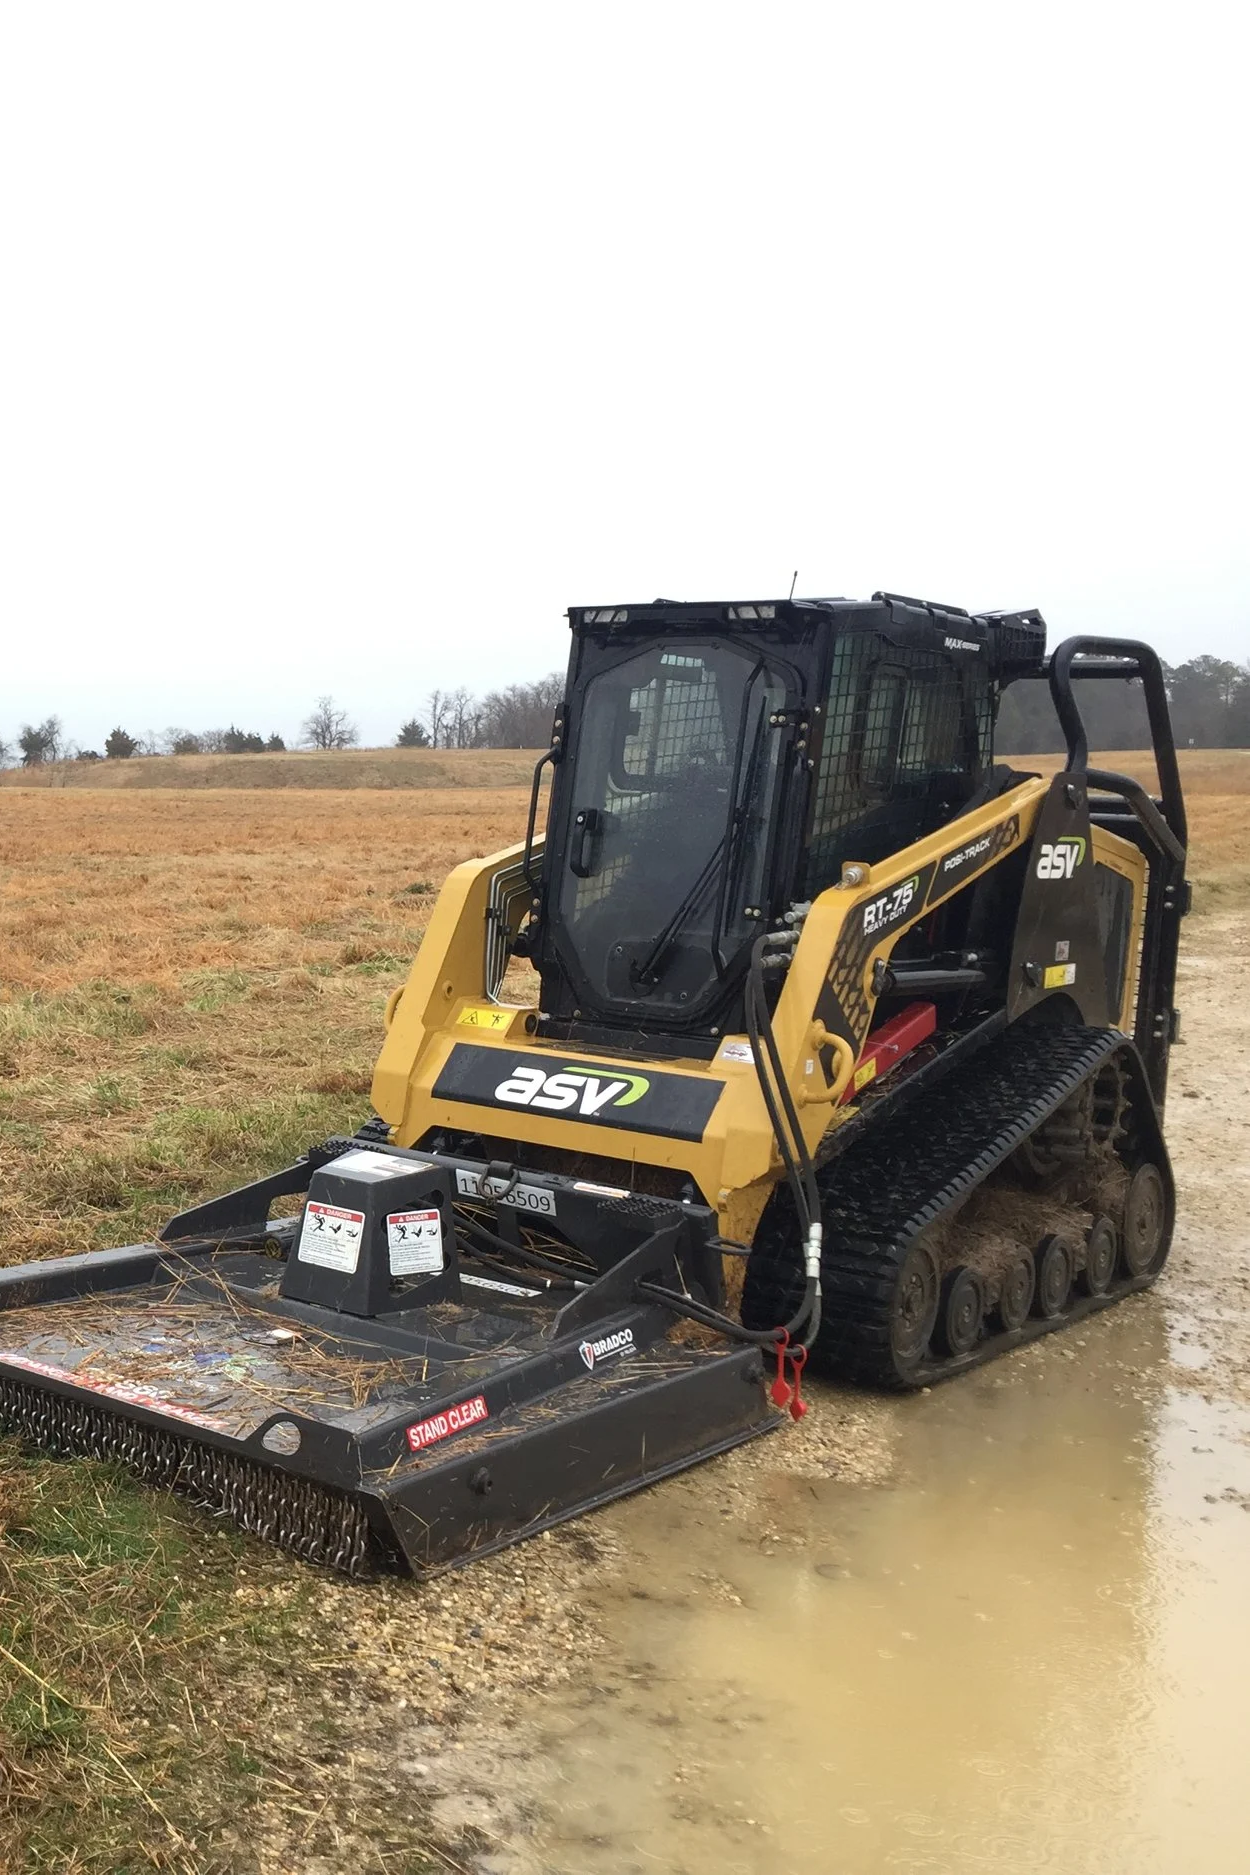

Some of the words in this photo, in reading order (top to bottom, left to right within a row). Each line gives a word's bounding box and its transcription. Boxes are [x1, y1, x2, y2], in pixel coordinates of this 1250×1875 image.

[944, 838, 991, 872] POSI-TRACK
[863, 882, 914, 928] RT-75
[863, 915, 889, 936] HEAVY
[889, 903, 908, 921] DUTY
[326, 1208, 353, 1220] DANGER
[405, 1213, 430, 1221] DANGER
[592, 1328, 633, 1357] BRADCO
[410, 1416, 449, 1448] STAND
[448, 1399, 485, 1430] CLEAR
